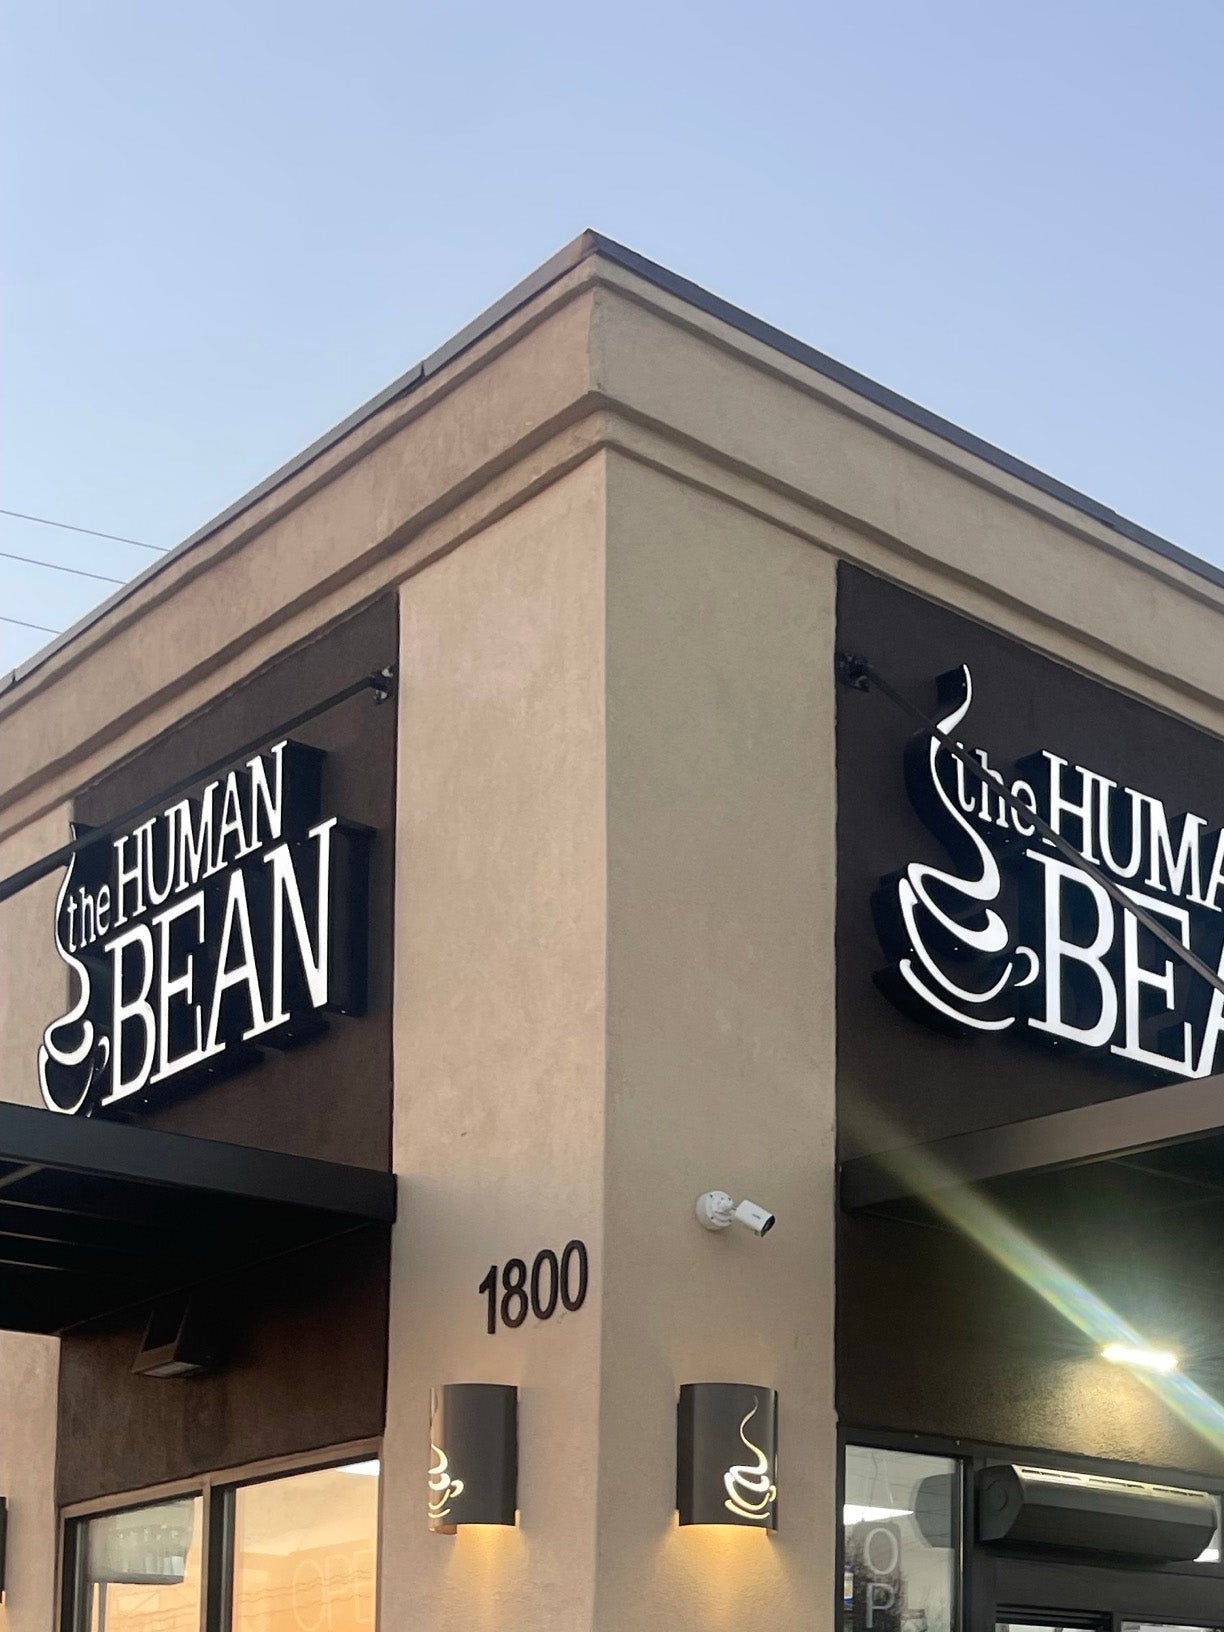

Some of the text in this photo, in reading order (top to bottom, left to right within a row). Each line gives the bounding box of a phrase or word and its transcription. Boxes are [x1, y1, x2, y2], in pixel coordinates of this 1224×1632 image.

[67, 740, 288, 952] the HUMAN
[951, 741, 1036, 837] the
[101, 816, 337, 1107] BEAN
[479, 1239, 588, 1334] 1800
